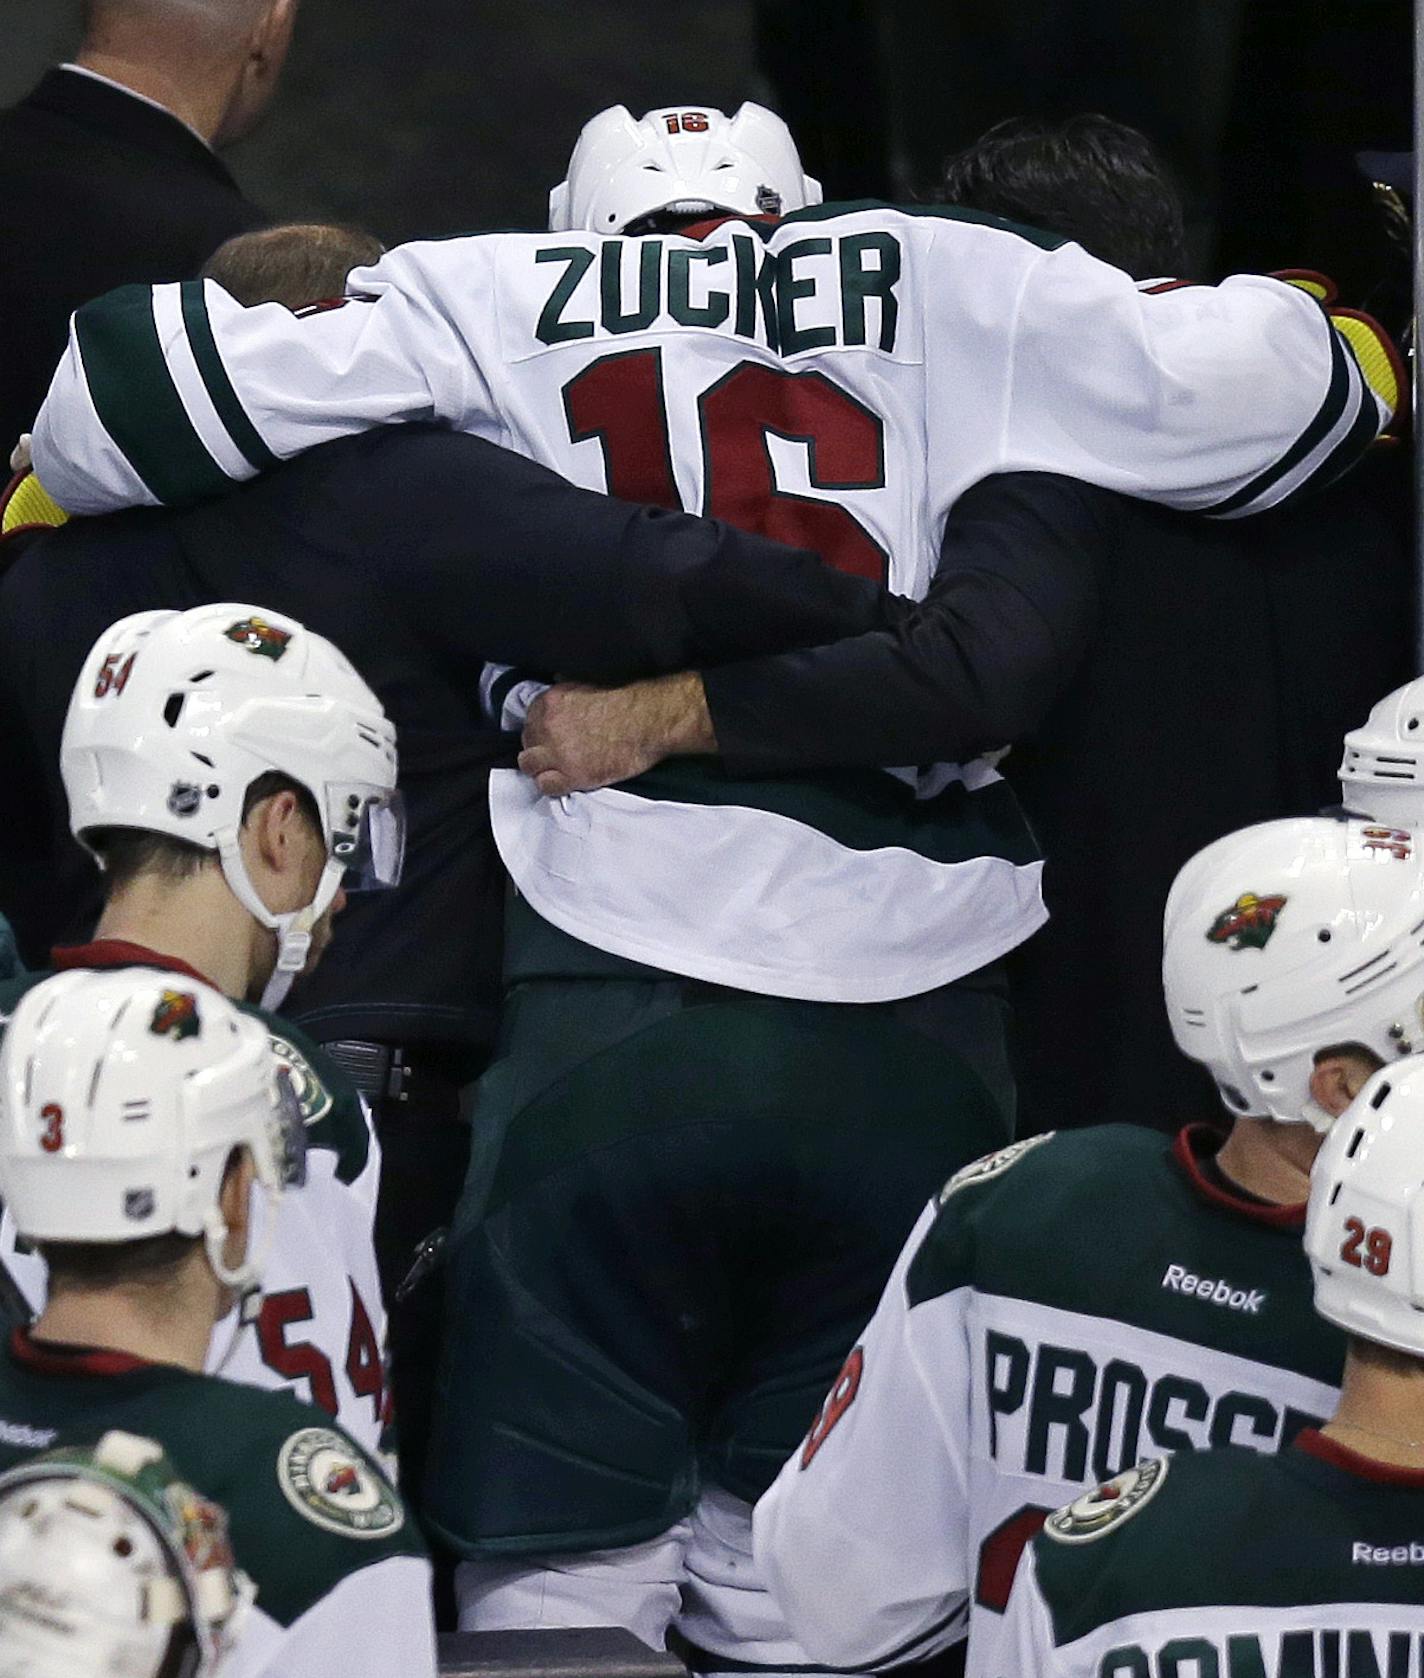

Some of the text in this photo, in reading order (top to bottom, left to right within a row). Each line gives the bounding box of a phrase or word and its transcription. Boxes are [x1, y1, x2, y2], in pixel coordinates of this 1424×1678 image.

[661, 112, 709, 134] 16
[534, 231, 901, 358] ZUCKER
[561, 346, 890, 583] 16
[95, 652, 137, 698] 54
[40, 1103, 64, 1152] 3
[1340, 1217, 1393, 1276] 29
[1161, 1264, 1265, 1313] Reebok
[252, 1274, 394, 1428] 54
